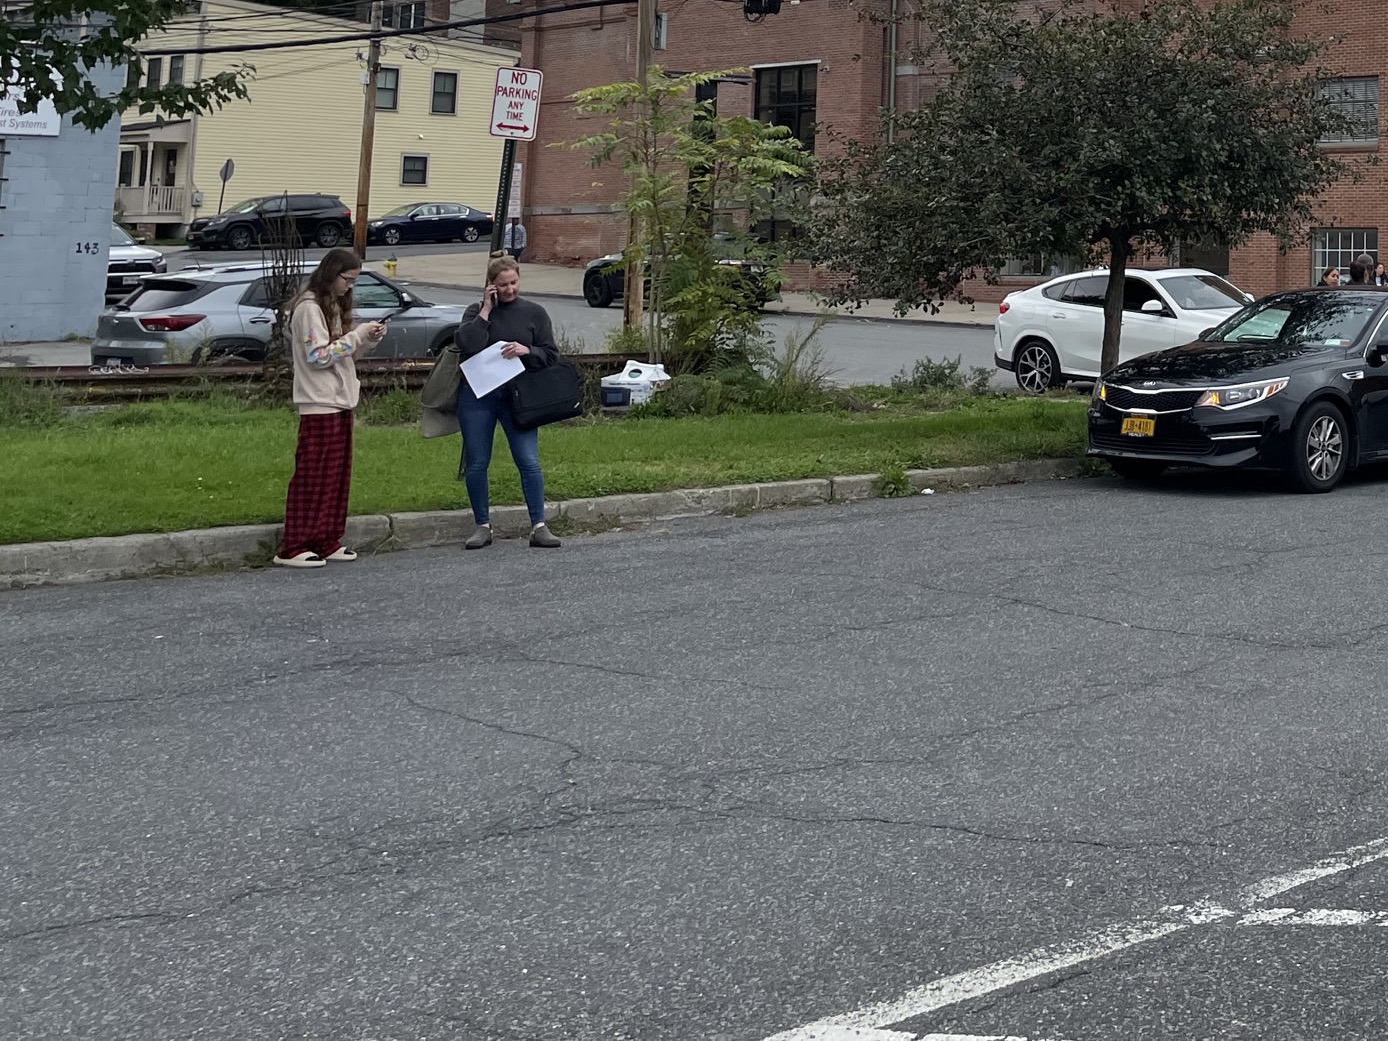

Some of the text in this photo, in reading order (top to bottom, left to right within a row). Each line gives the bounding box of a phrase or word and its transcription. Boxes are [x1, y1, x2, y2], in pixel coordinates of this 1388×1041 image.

[511, 71, 527, 85] NO
[496, 85, 538, 101] PARKING
[508, 100, 524, 111] ANY
[506, 111, 524, 121] TIME
[9, 118, 48, 130] Systems
[75, 241, 100, 255] 143
